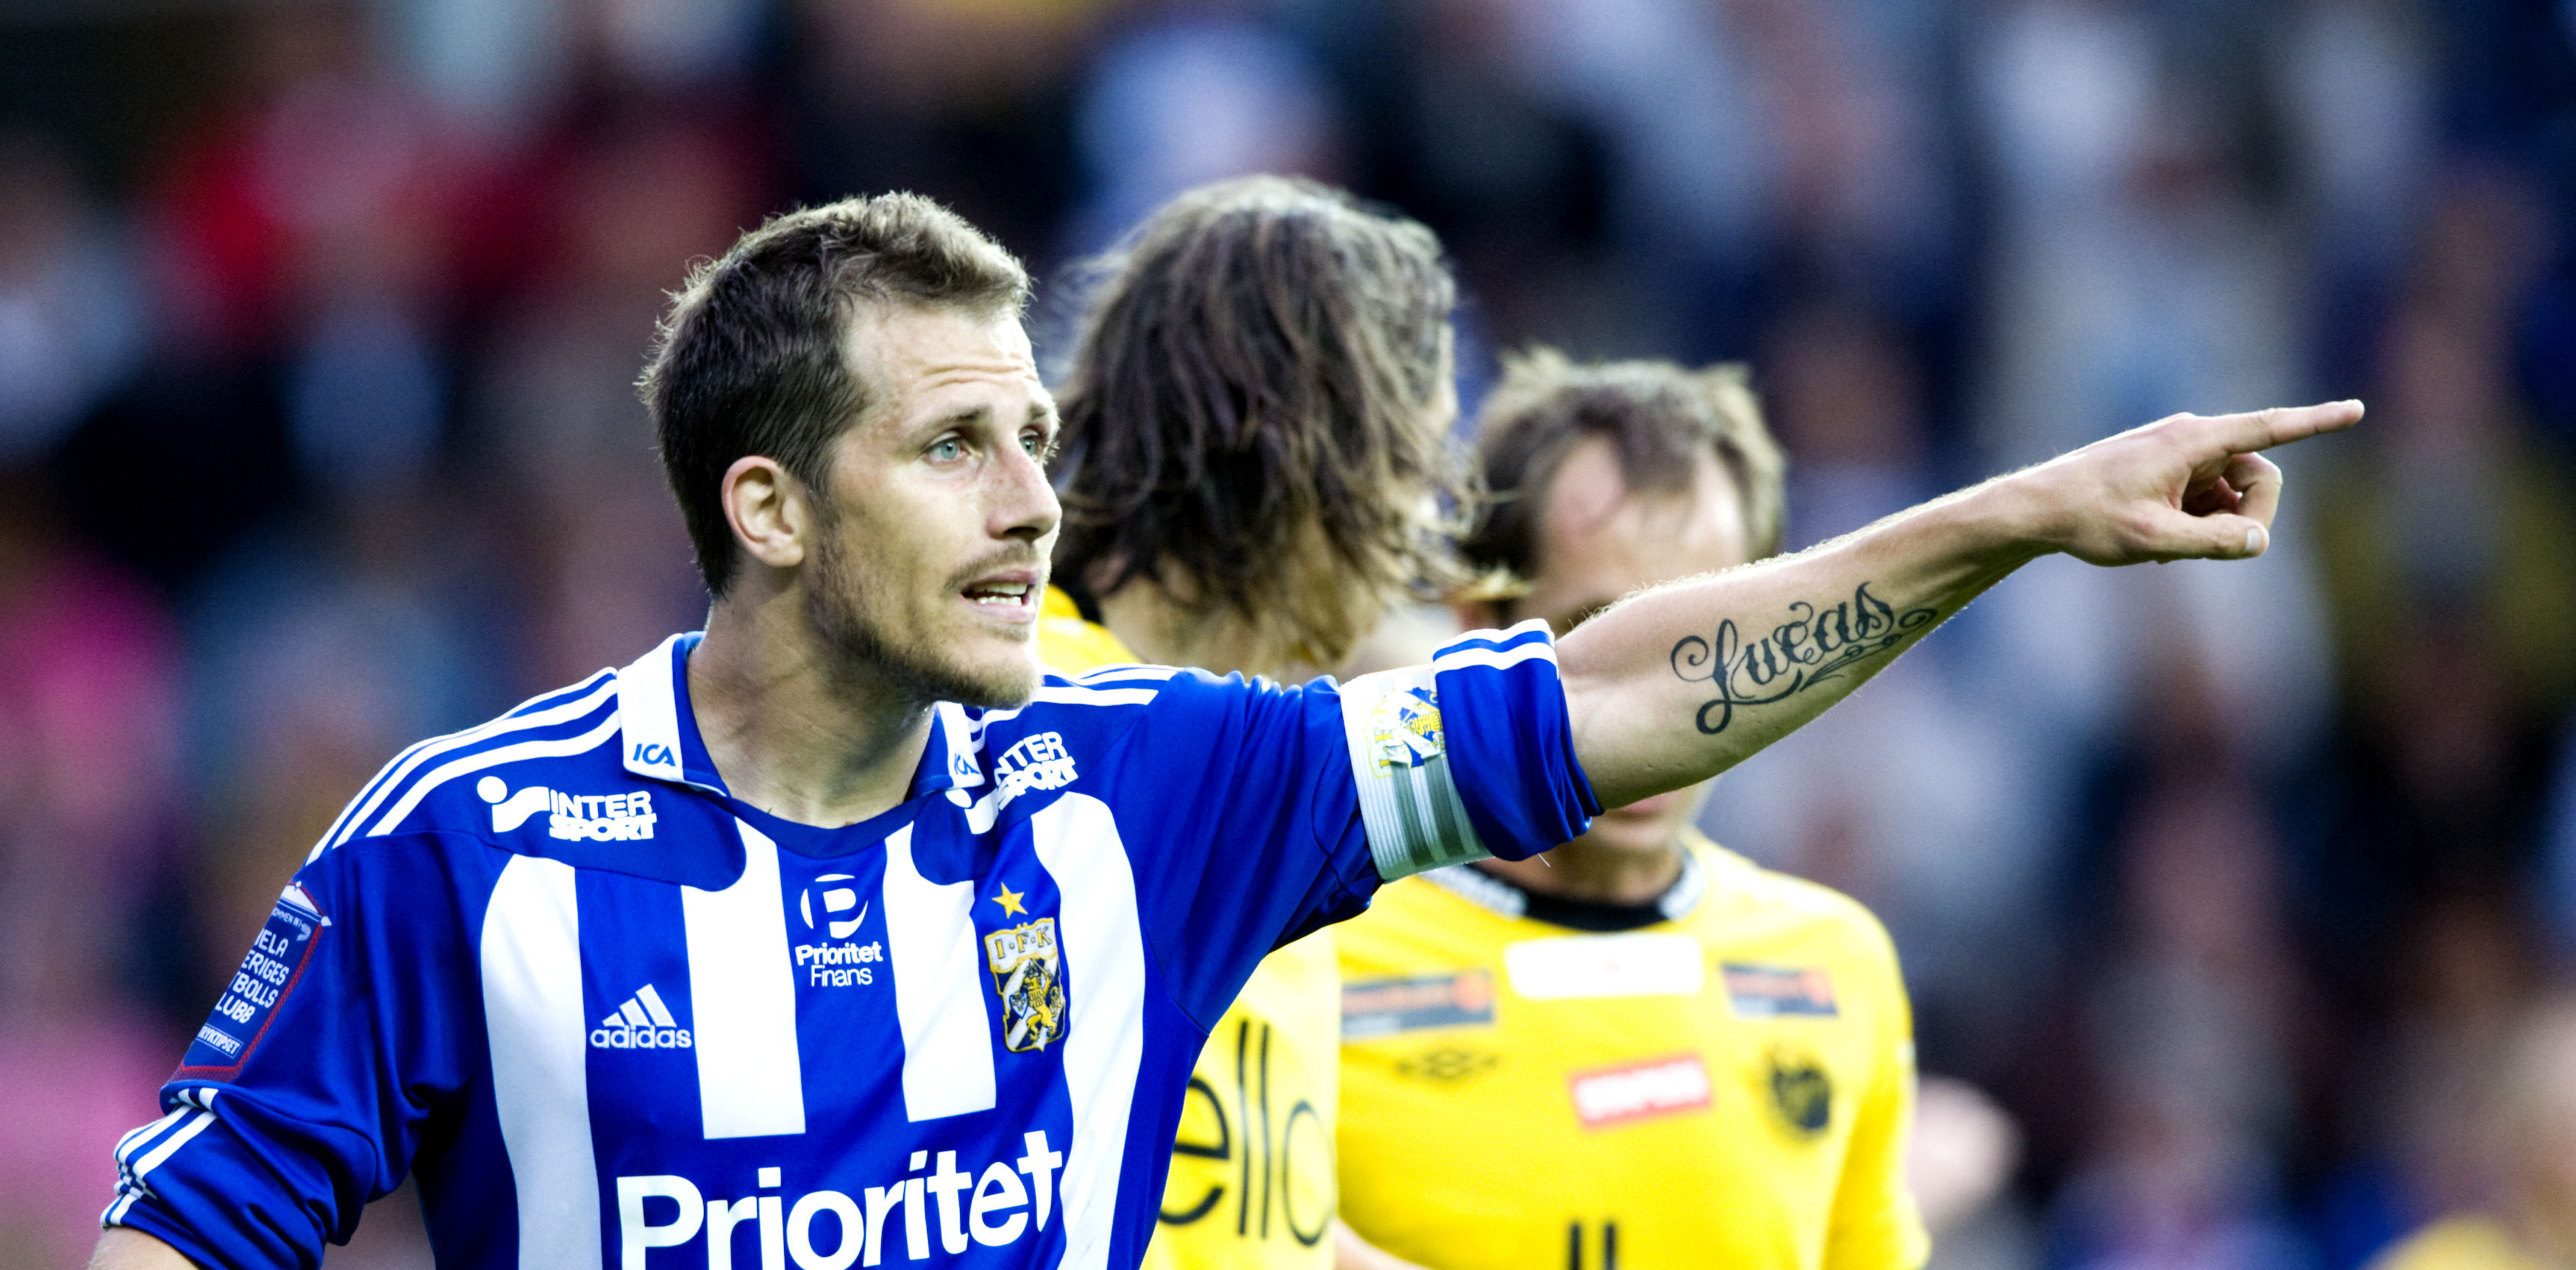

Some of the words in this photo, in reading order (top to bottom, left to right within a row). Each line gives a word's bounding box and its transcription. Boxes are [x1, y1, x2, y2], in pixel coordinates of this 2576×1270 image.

[1671, 581, 1896, 735] Lucas
[633, 743, 676, 767] ICA
[994, 732, 1067, 787] NTER
[550, 789, 652, 819] INTER
[549, 813, 657, 841] SPORT
[795, 941, 883, 966] Prioritet
[811, 965, 873, 987] Finans
[590, 1024, 692, 1049] adidas
[616, 1130, 1062, 1270] Prioritet
